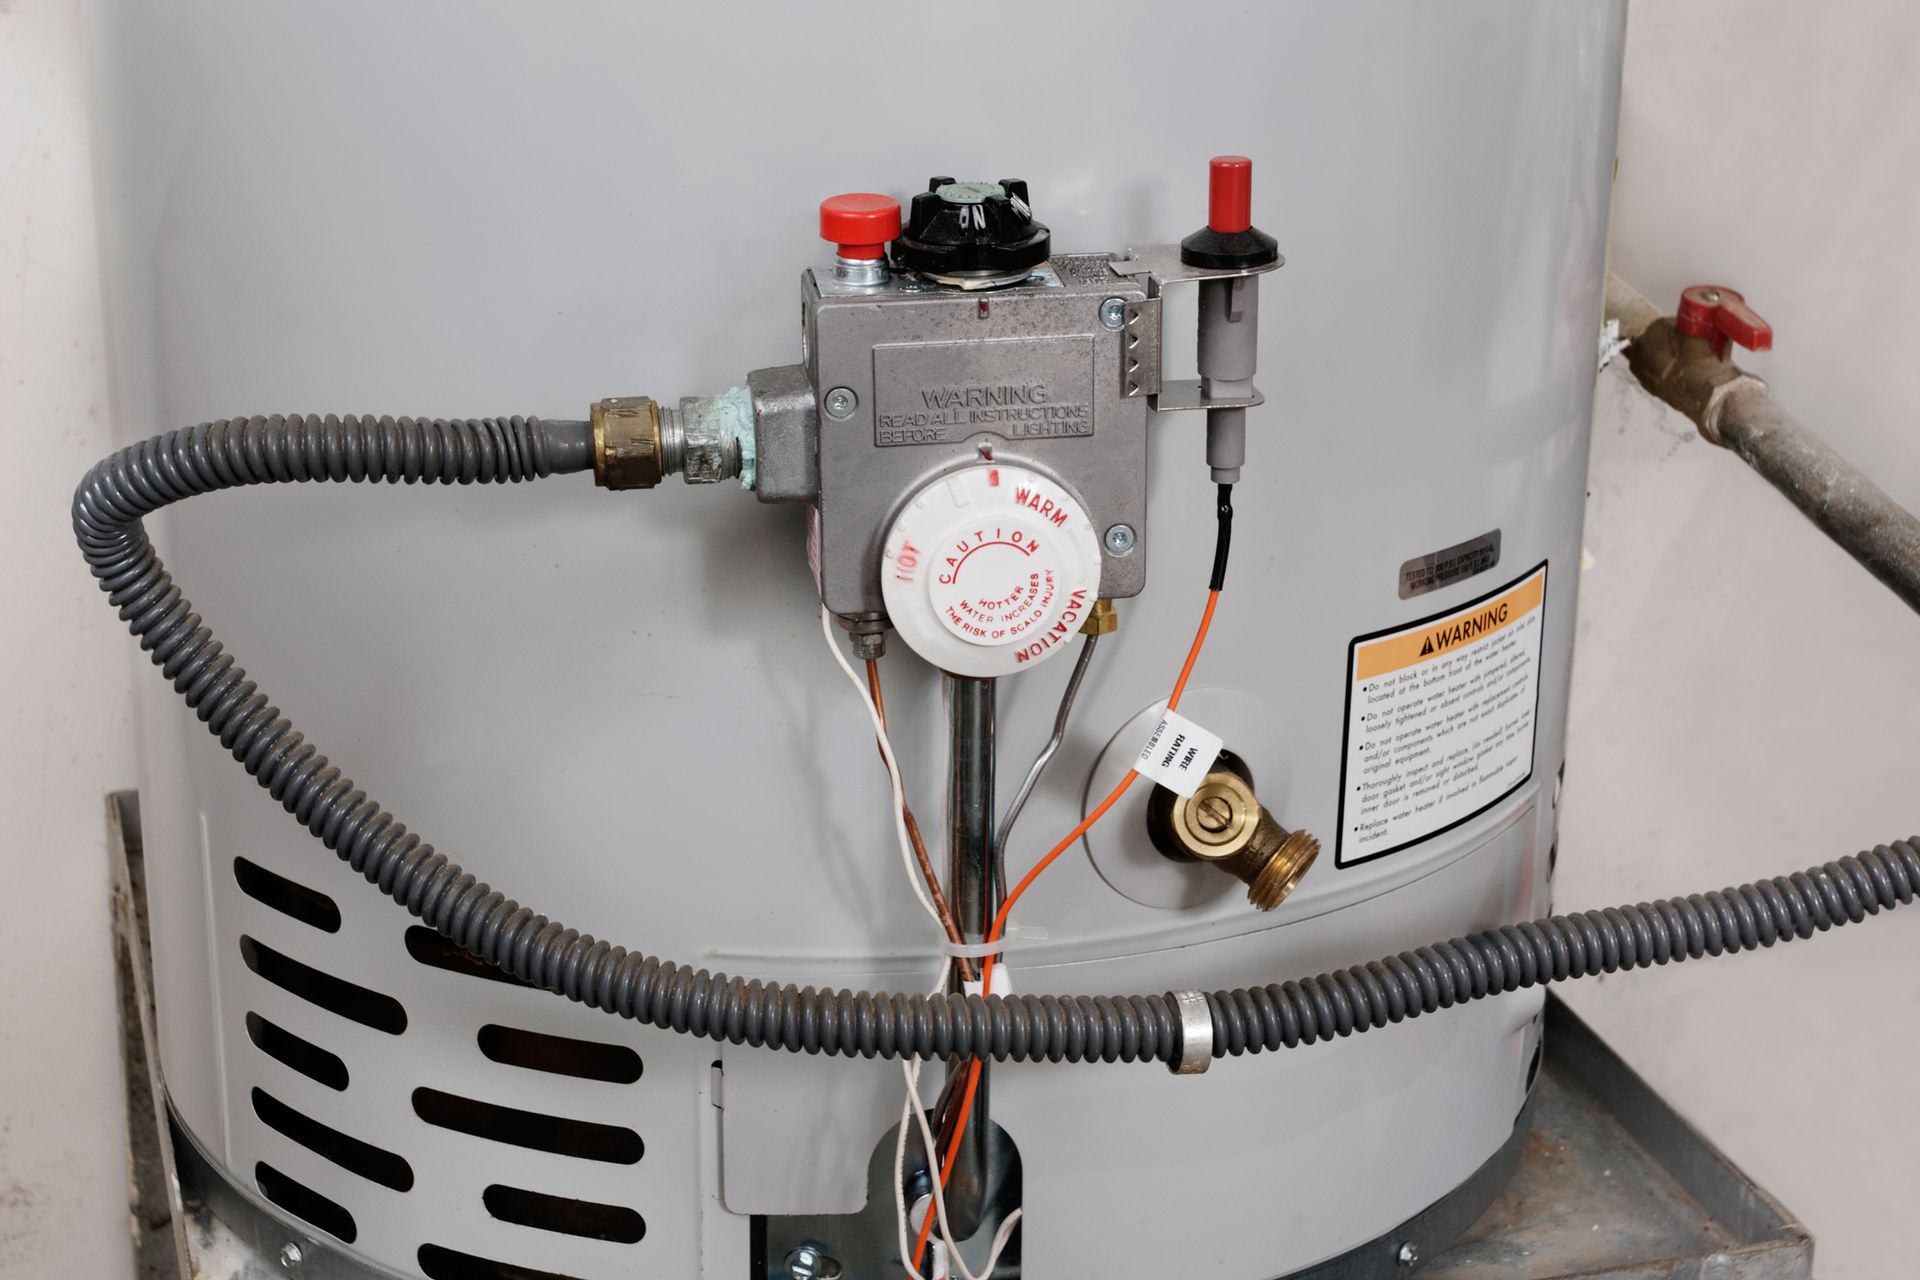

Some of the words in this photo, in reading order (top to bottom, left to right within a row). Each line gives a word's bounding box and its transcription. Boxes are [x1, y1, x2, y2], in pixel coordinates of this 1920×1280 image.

[960, 204, 986, 230] ON
[921, 384, 1046, 410] WARNING
[879, 413, 928, 428] READ
[932, 409, 967, 426] ALL
[969, 403, 1088, 424] INSTRUCTIONS
[880, 428, 948, 444] BEFORE
[1012, 420, 1088, 437] LIGHTING
[1015, 487, 1069, 528] WARM
[939, 528, 1040, 584] CAUTION
[945, 605, 961, 626] THE
[961, 623, 987, 638] RISK
[991, 628, 1006, 639] OF
[1010, 609, 1042, 636] SCALD
[1042, 568, 1055, 608] INJURY
[960, 600, 994, 623] WATER
[1001, 572, 1039, 623] INCREASES
[979, 585, 1024, 610] HOTTER
[1015, 589, 1087, 664] VACATION
[1435, 603, 1508, 650] WARNING
[1368, 689, 1395, 704] located
[1409, 682, 1420, 691] the
[1424, 675, 1445, 687] bottom
[1369, 683, 1380, 692] Do
[1384, 678, 1395, 687] not
[1399, 670, 1417, 683] block
[1367, 713, 1377, 721] Do
[1382, 708, 1394, 717] not
[1397, 699, 1423, 713] operate
[1428, 691, 1445, 701] water
[1448, 682, 1467, 694] heater
[1365, 742, 1376, 750] Do
[1380, 736, 1392, 746] not
[1395, 728, 1421, 743] operate
[1426, 720, 1443, 730] water
[1446, 710, 1465, 723] heater
[1366, 719, 1392, 734] loosely
[1396, 706, 1427, 725] tightened
[1161, 734, 1186, 768] RATING
[1178, 747, 1198, 772] WIRE
[1364, 749, 1390, 762] and/or
[1394, 735, 1433, 754] components
[1437, 725, 1454, 737] which
[1361, 793, 1379, 803] door
[1383, 783, 1406, 799] gasket
[1409, 774, 1432, 788] and/or
[1452, 757, 1474, 769] window
[1363, 758, 1391, 774] original
[1363, 772, 1401, 791] Thoroughly
[1406, 764, 1429, 778] inspect
[1432, 756, 1444, 768] and
[1361, 804, 1379, 815] inner
[1383, 797, 1400, 808] door
[1413, 781, 1440, 797] removed
[1360, 819, 1388, 832] Replace
[1393, 810, 1412, 821] water
[1415, 801, 1436, 813] heater
